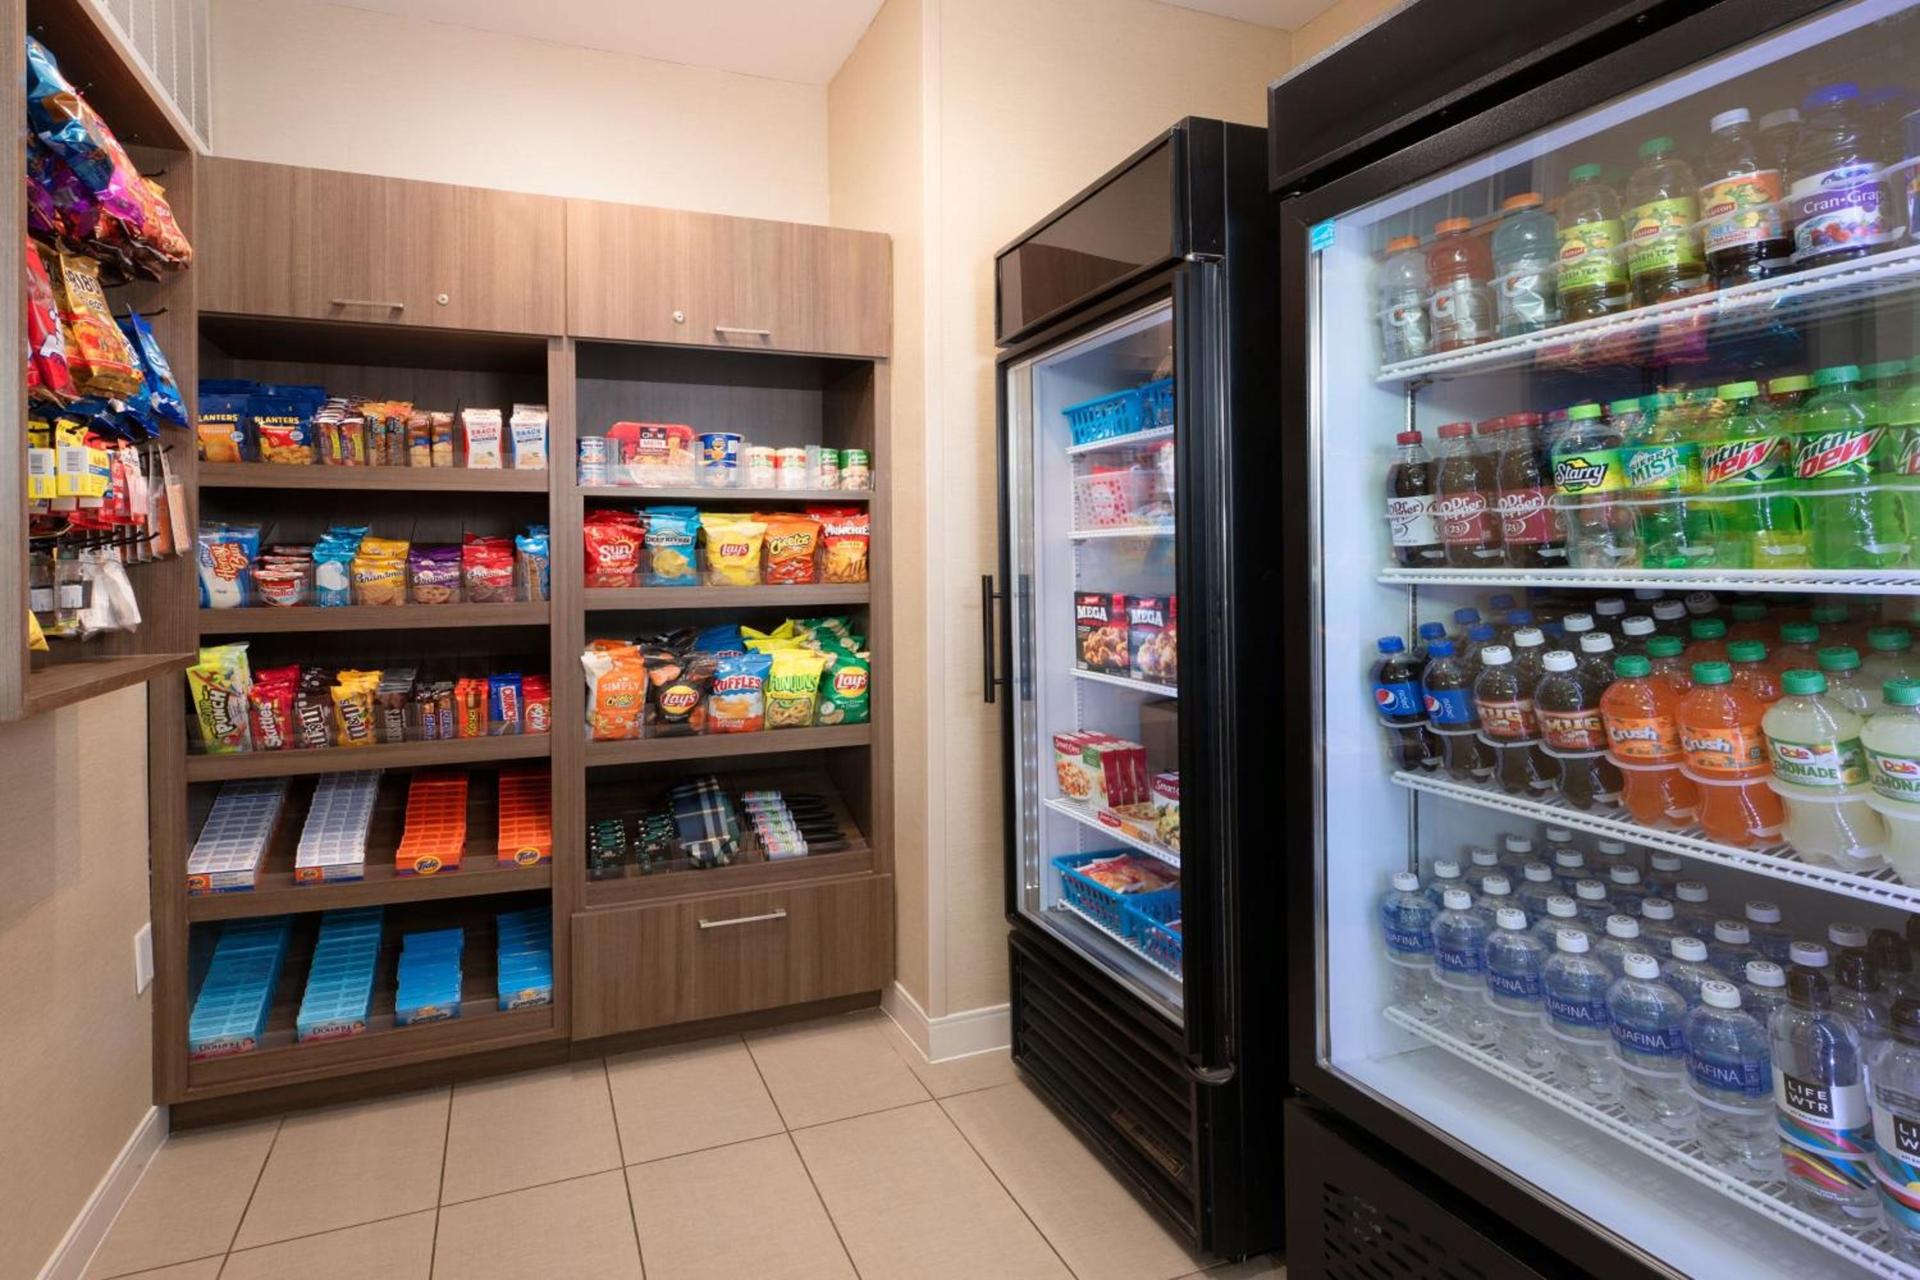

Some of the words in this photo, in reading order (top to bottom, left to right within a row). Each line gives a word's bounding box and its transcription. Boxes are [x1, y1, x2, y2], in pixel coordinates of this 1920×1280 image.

[63, 269, 101, 295] RIBO
[198, 413, 239, 422] LANTERS
[254, 416, 300, 424] PLANTERS
[1555, 463, 1606, 487] Starry
[1631, 454, 1676, 485] MIST
[1451, 497, 1469, 509] Dr
[1077, 605, 1108, 622] MEGA
[1131, 608, 1164, 628] MEGA
[712, 675, 761, 692] RUFFLES
[502, 687, 515, 719] CRUNCH
[209, 689, 235, 737] PUNCH
[259, 702, 283, 747] Skittles
[1609, 727, 1658, 743] Crush
[1682, 737, 1732, 754] Crush
[1780, 746, 1809, 760] Dole
[1774, 760, 1838, 779] EMONADE
[1883, 760, 1917, 775] Dole
[1872, 773, 1920, 792] EMONA
[517, 851, 538, 862] Tide
[416, 862, 438, 873] Tide
[1391, 934, 1422, 948] AFINA
[1439, 951, 1465, 968] FINA
[1546, 1000, 1593, 1020] UAFINA
[1696, 1061, 1744, 1086] AFINA
[1788, 1080, 1828, 1101] LIFE
[1789, 1091, 1829, 1114] WTR
